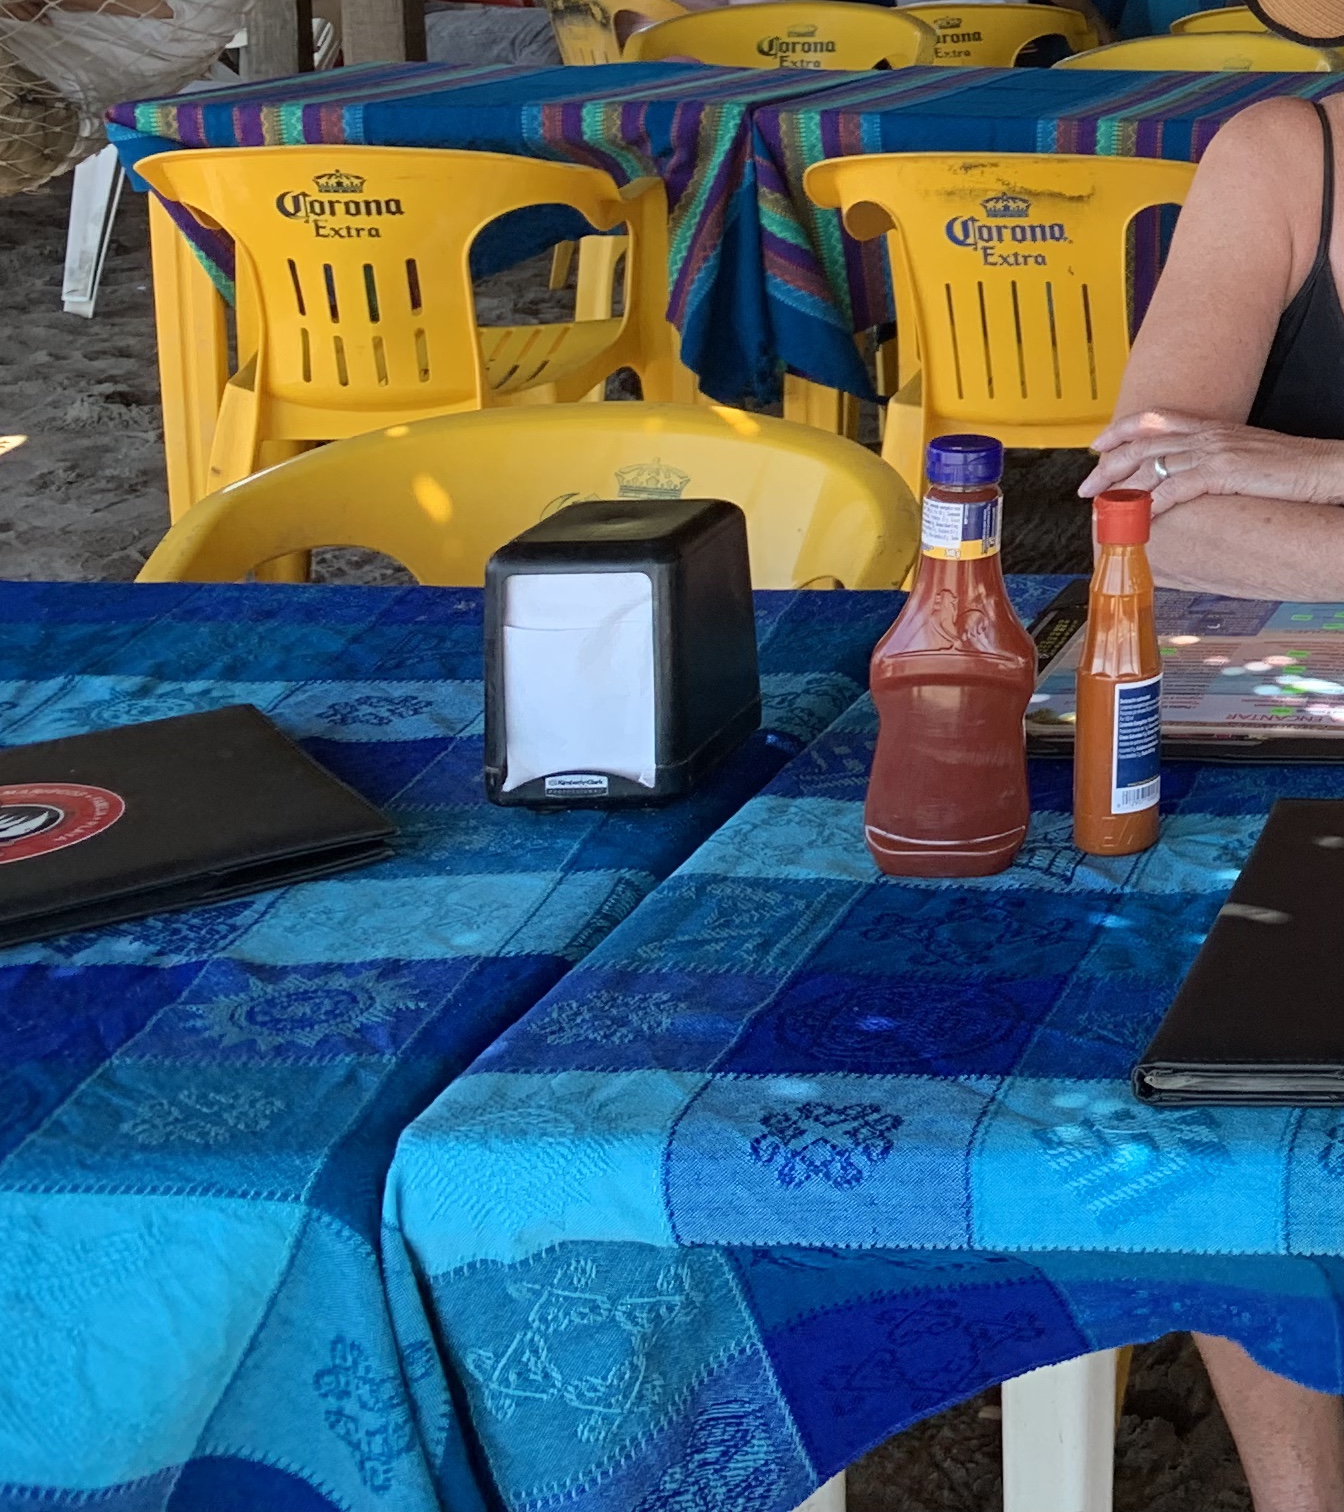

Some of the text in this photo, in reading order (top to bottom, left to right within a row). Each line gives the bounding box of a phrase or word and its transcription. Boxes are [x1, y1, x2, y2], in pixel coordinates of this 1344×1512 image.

[756, 35, 836, 59] Corona
[933, 46, 971, 59] Extra
[276, 190, 405, 224] Corona
[313, 219, 381, 239] Extra
[945, 215, 1068, 251] Corona
[981, 245, 1047, 266] Extra
